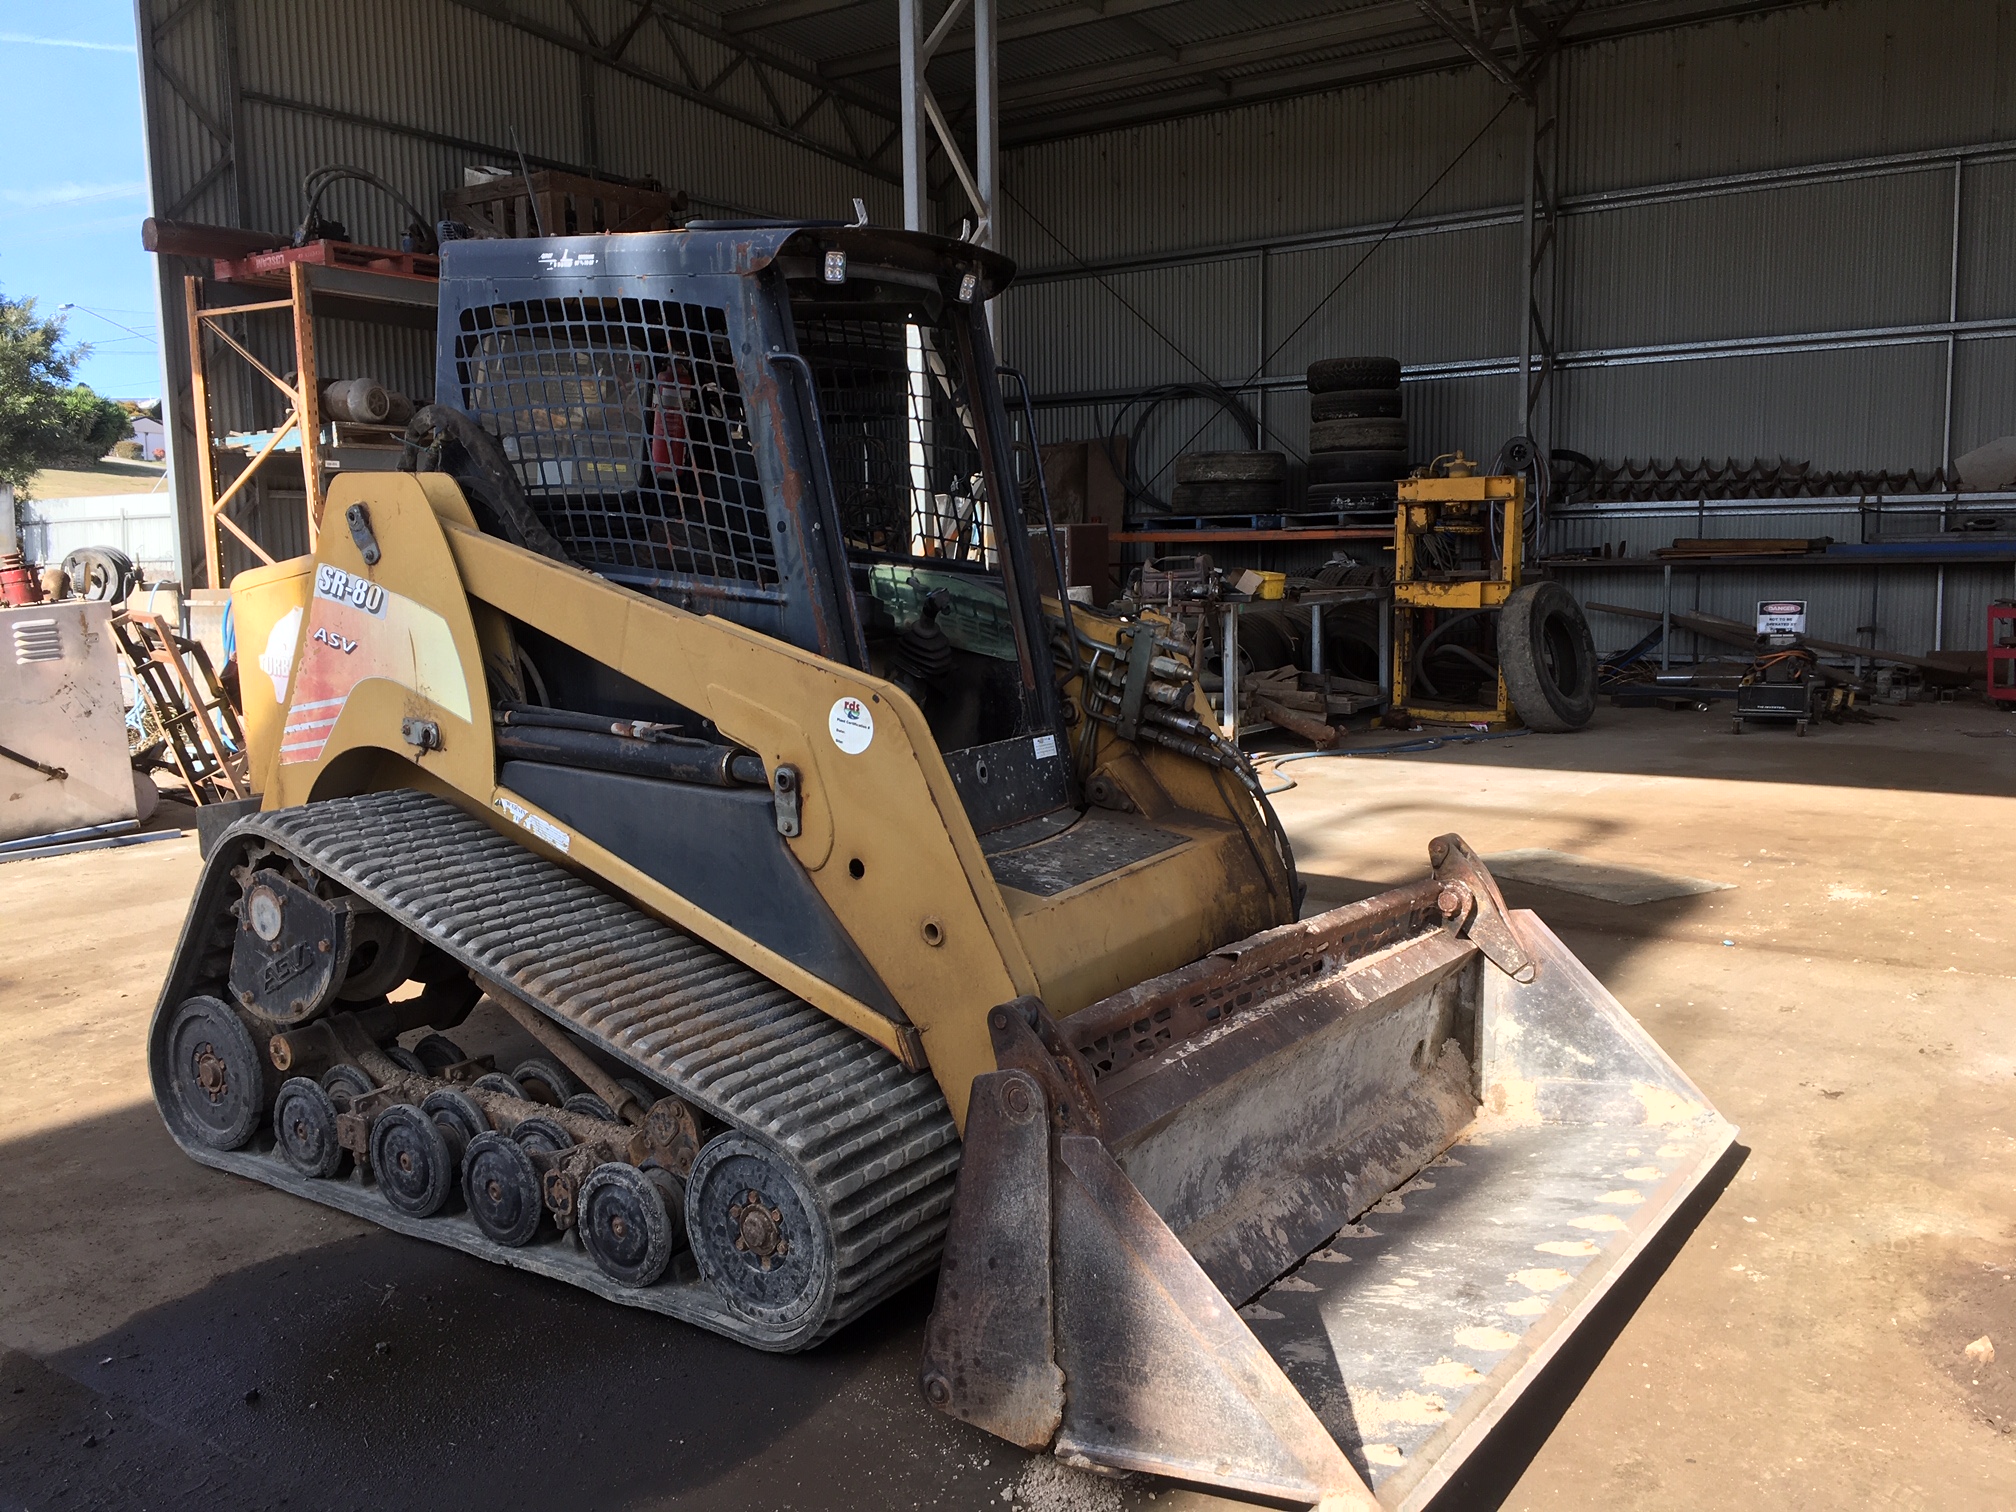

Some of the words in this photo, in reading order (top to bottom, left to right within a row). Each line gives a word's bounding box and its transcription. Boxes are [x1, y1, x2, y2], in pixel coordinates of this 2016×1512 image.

[317, 564, 384, 615] SR-80
[313, 627, 358, 655] ASV
[258, 654, 291, 678] TURB
[844, 701, 860, 712] rds
[264, 942, 314, 995] ASV
